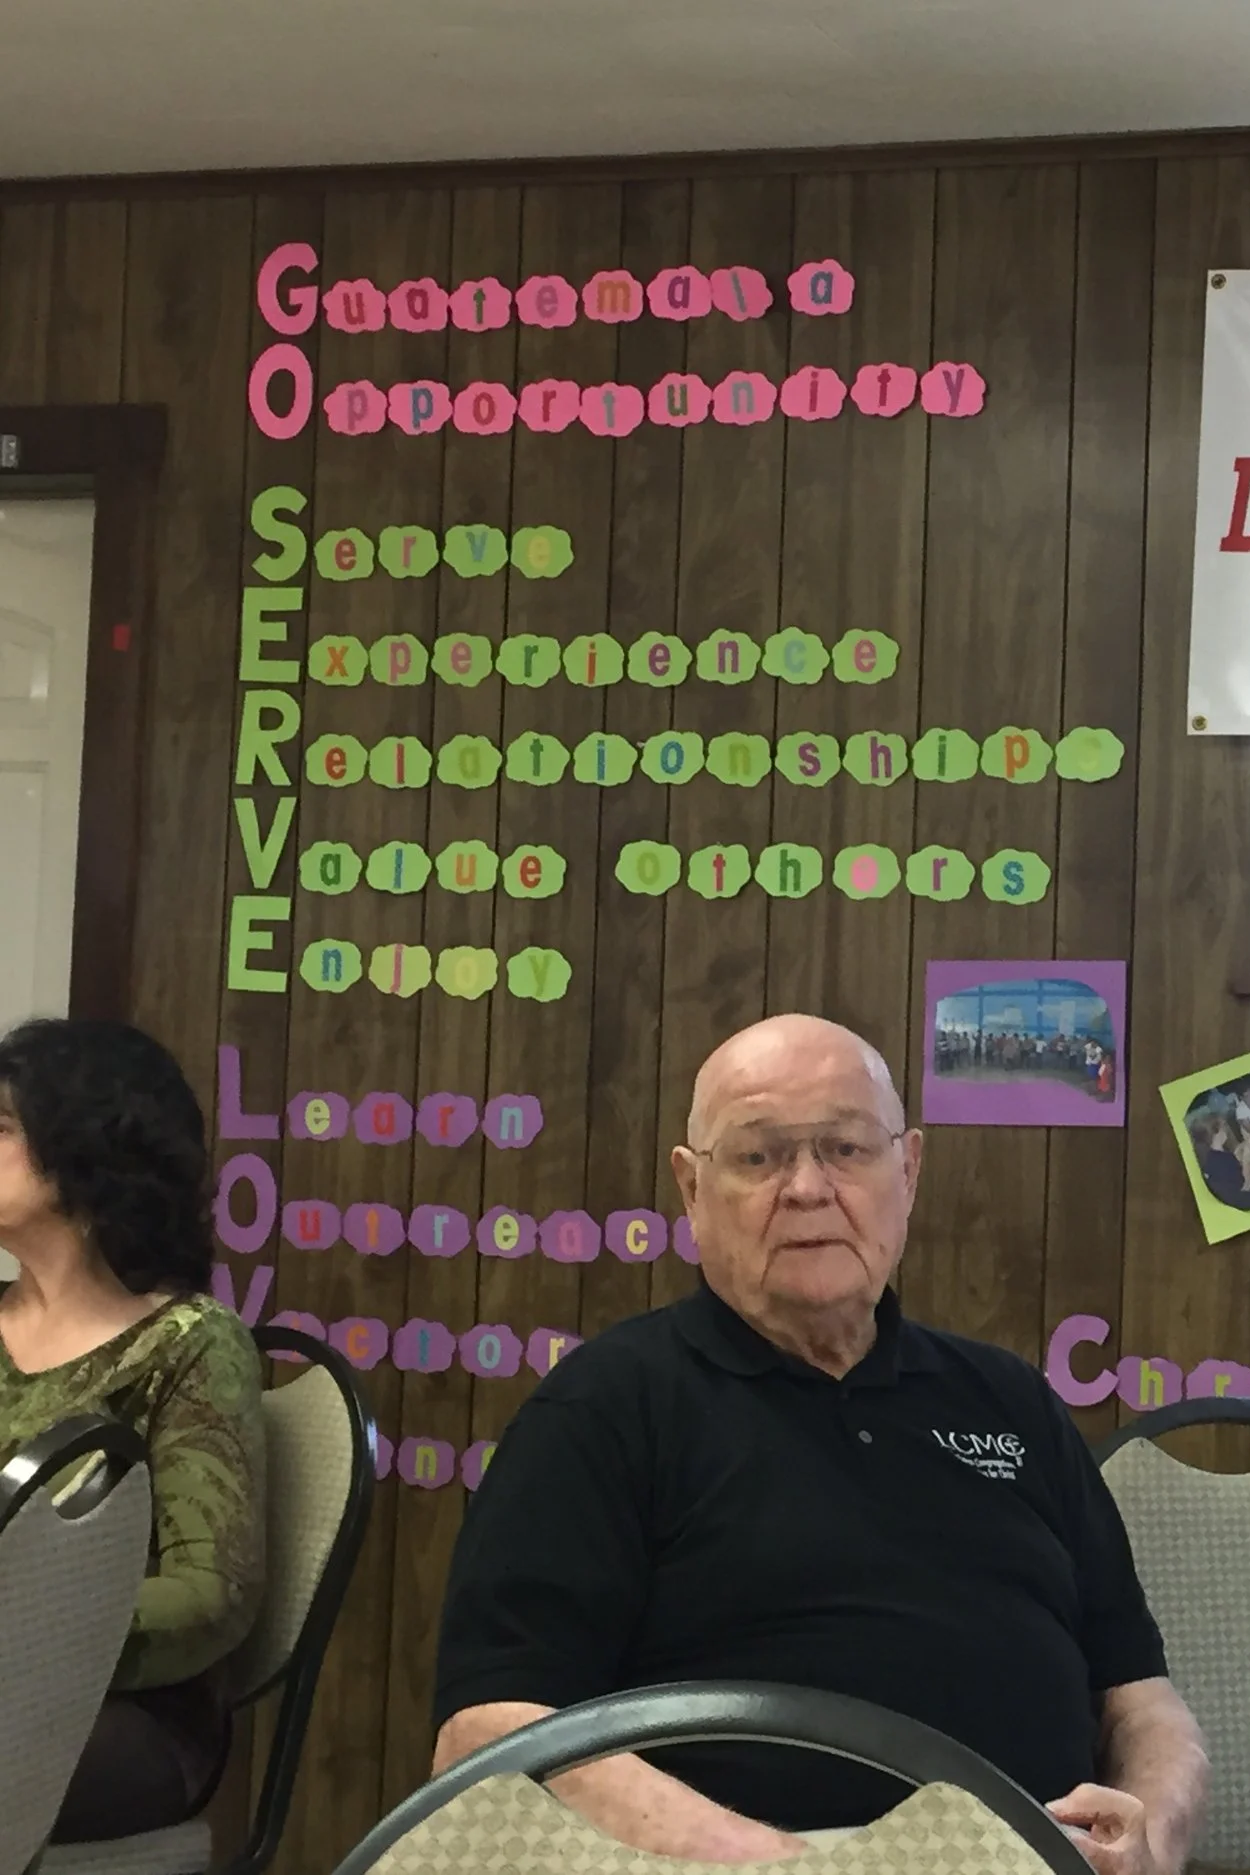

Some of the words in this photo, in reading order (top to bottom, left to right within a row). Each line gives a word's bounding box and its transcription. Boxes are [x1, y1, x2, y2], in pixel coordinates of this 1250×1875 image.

[257, 242, 834, 336] Guatemala
[249, 343, 966, 440] Opportunity
[250, 485, 551, 582] Serve
[239, 587, 877, 684] Experience
[236, 690, 1102, 787] Relationships
[234, 798, 542, 890] Value
[636, 846, 1026, 898] others
[227, 896, 551, 993] Enjoy
[218, 1044, 524, 1141] Learn
[213, 1153, 652, 1254] Outreac
